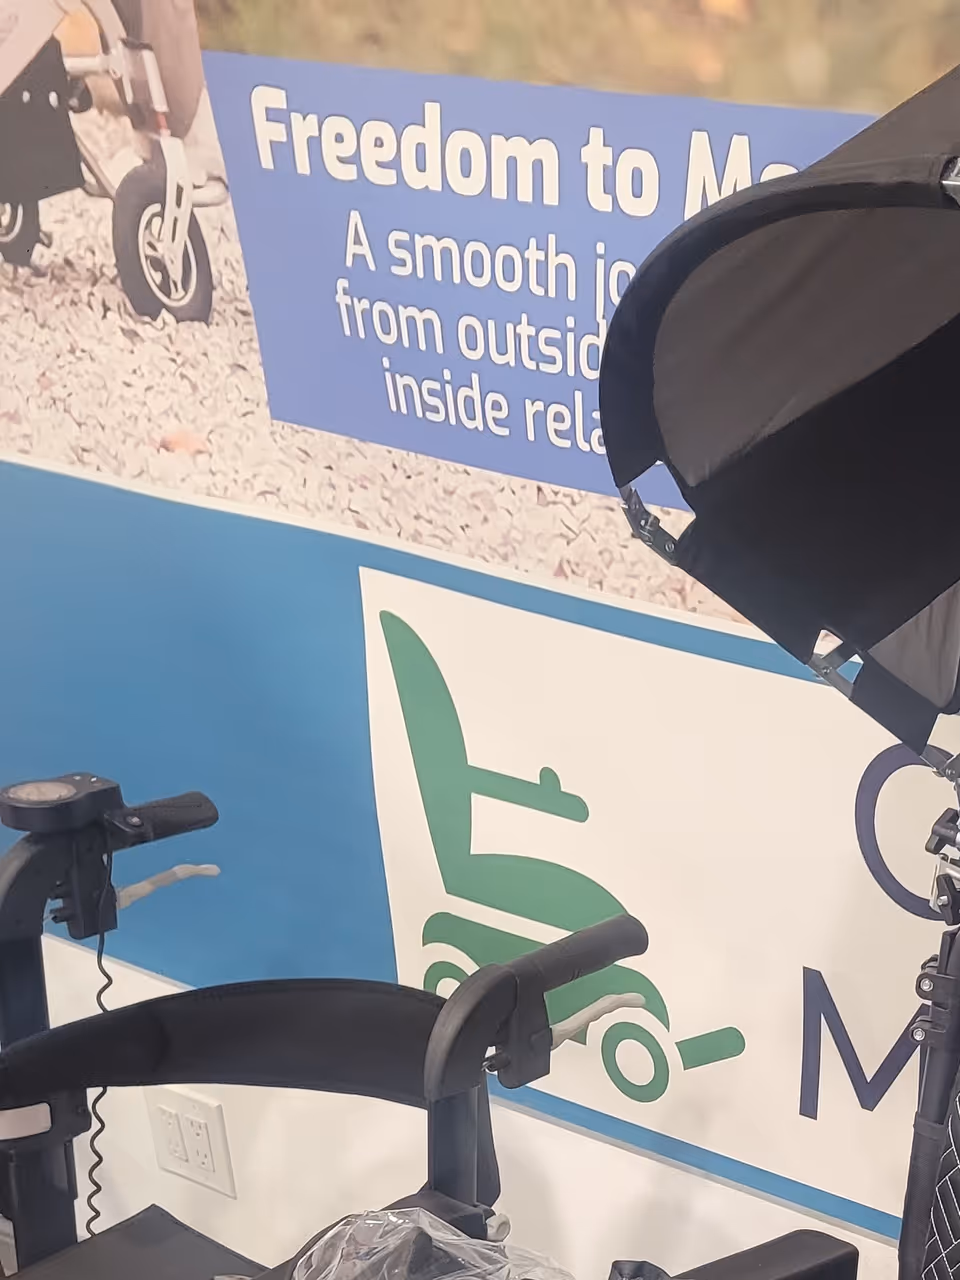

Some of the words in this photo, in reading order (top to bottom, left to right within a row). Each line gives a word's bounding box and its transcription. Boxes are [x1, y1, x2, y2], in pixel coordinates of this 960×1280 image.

[250, 84, 560, 206] Freedom
[580, 126, 660, 218] to
[684, 130, 800, 222] M
[345, 209, 376, 272] A
[387, 233, 577, 301] smooth
[335, 277, 444, 354] from
[457, 312, 607, 381] outsid
[381, 357, 511, 437] inside
